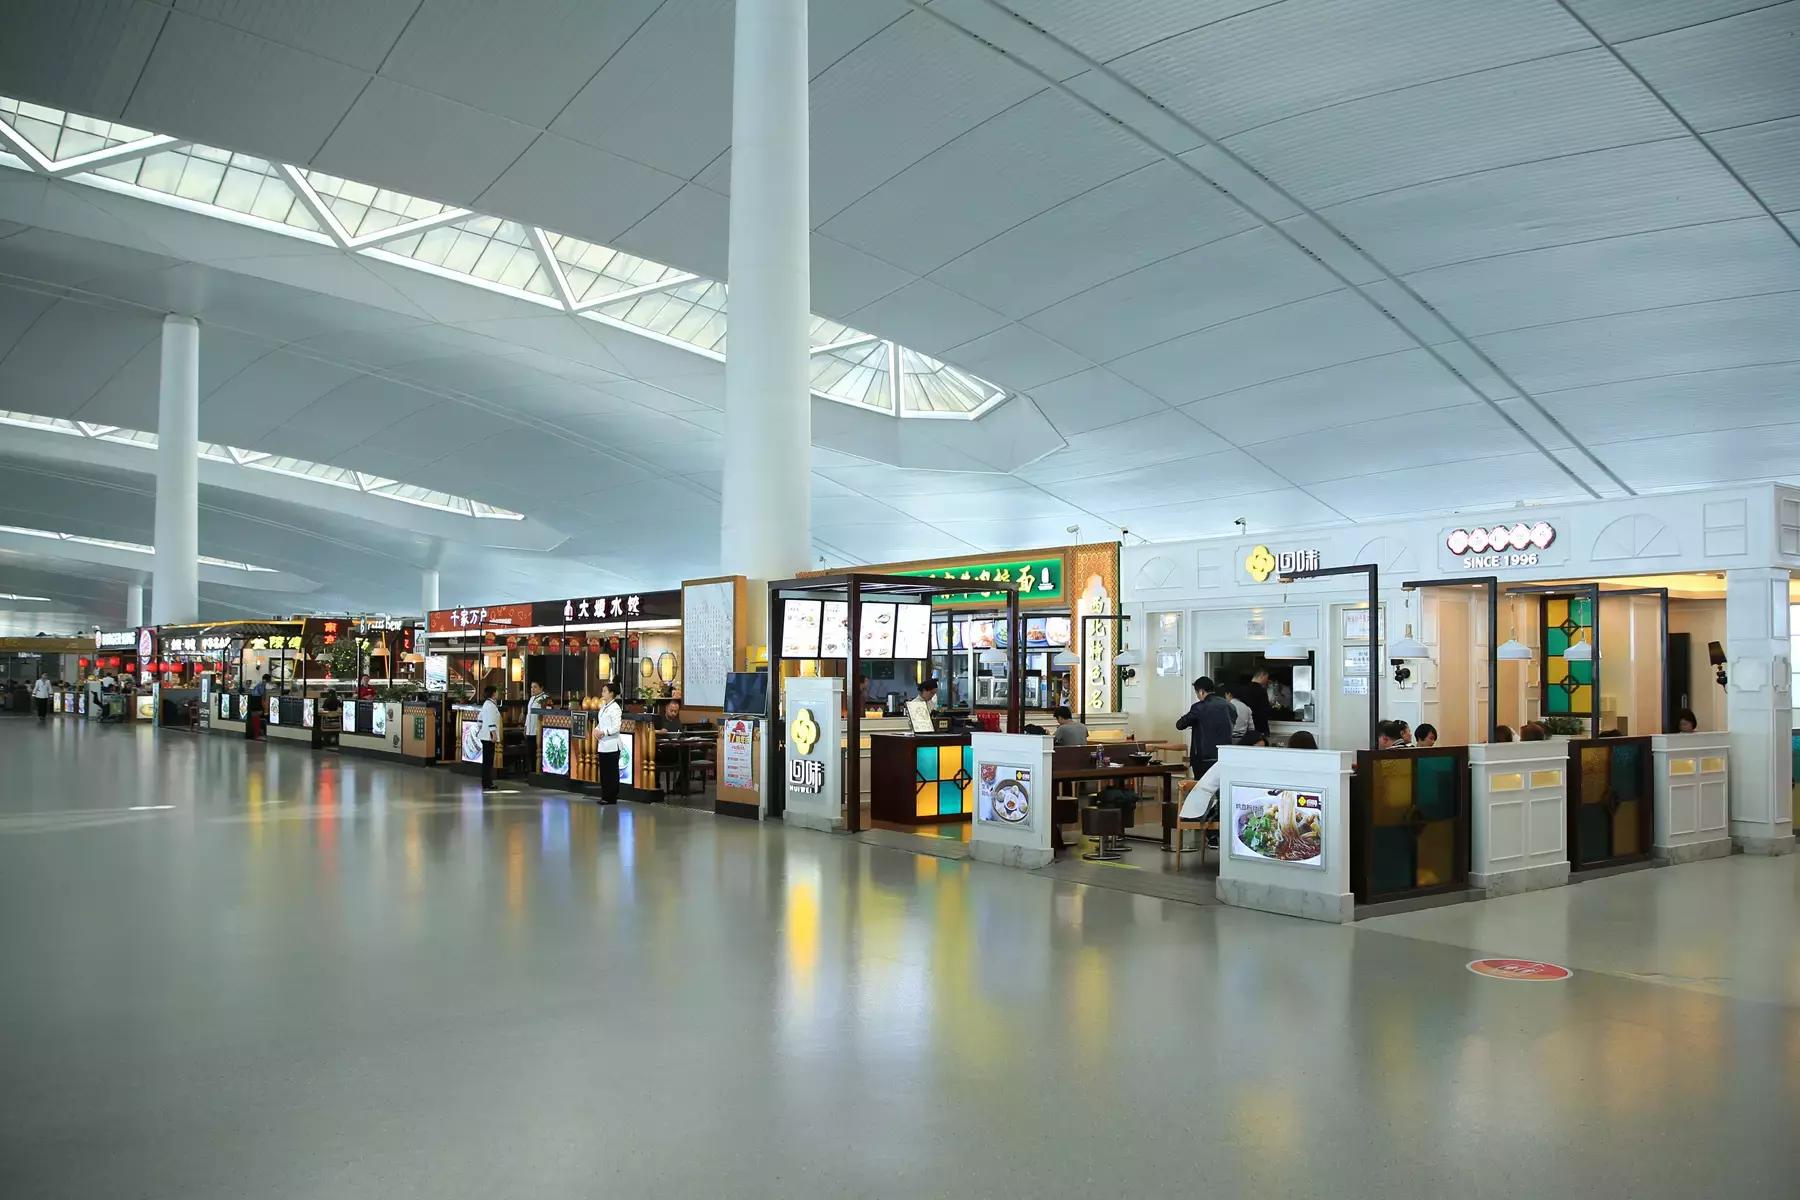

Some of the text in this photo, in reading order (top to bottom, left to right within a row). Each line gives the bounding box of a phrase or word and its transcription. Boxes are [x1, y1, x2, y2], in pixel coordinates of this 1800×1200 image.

[1277, 550, 1320, 573] 回味
[1463, 553, 1538, 568] SINCE 1996
[450, 607, 487, 627] 千家万户
[790, 760, 822, 794] 回味
